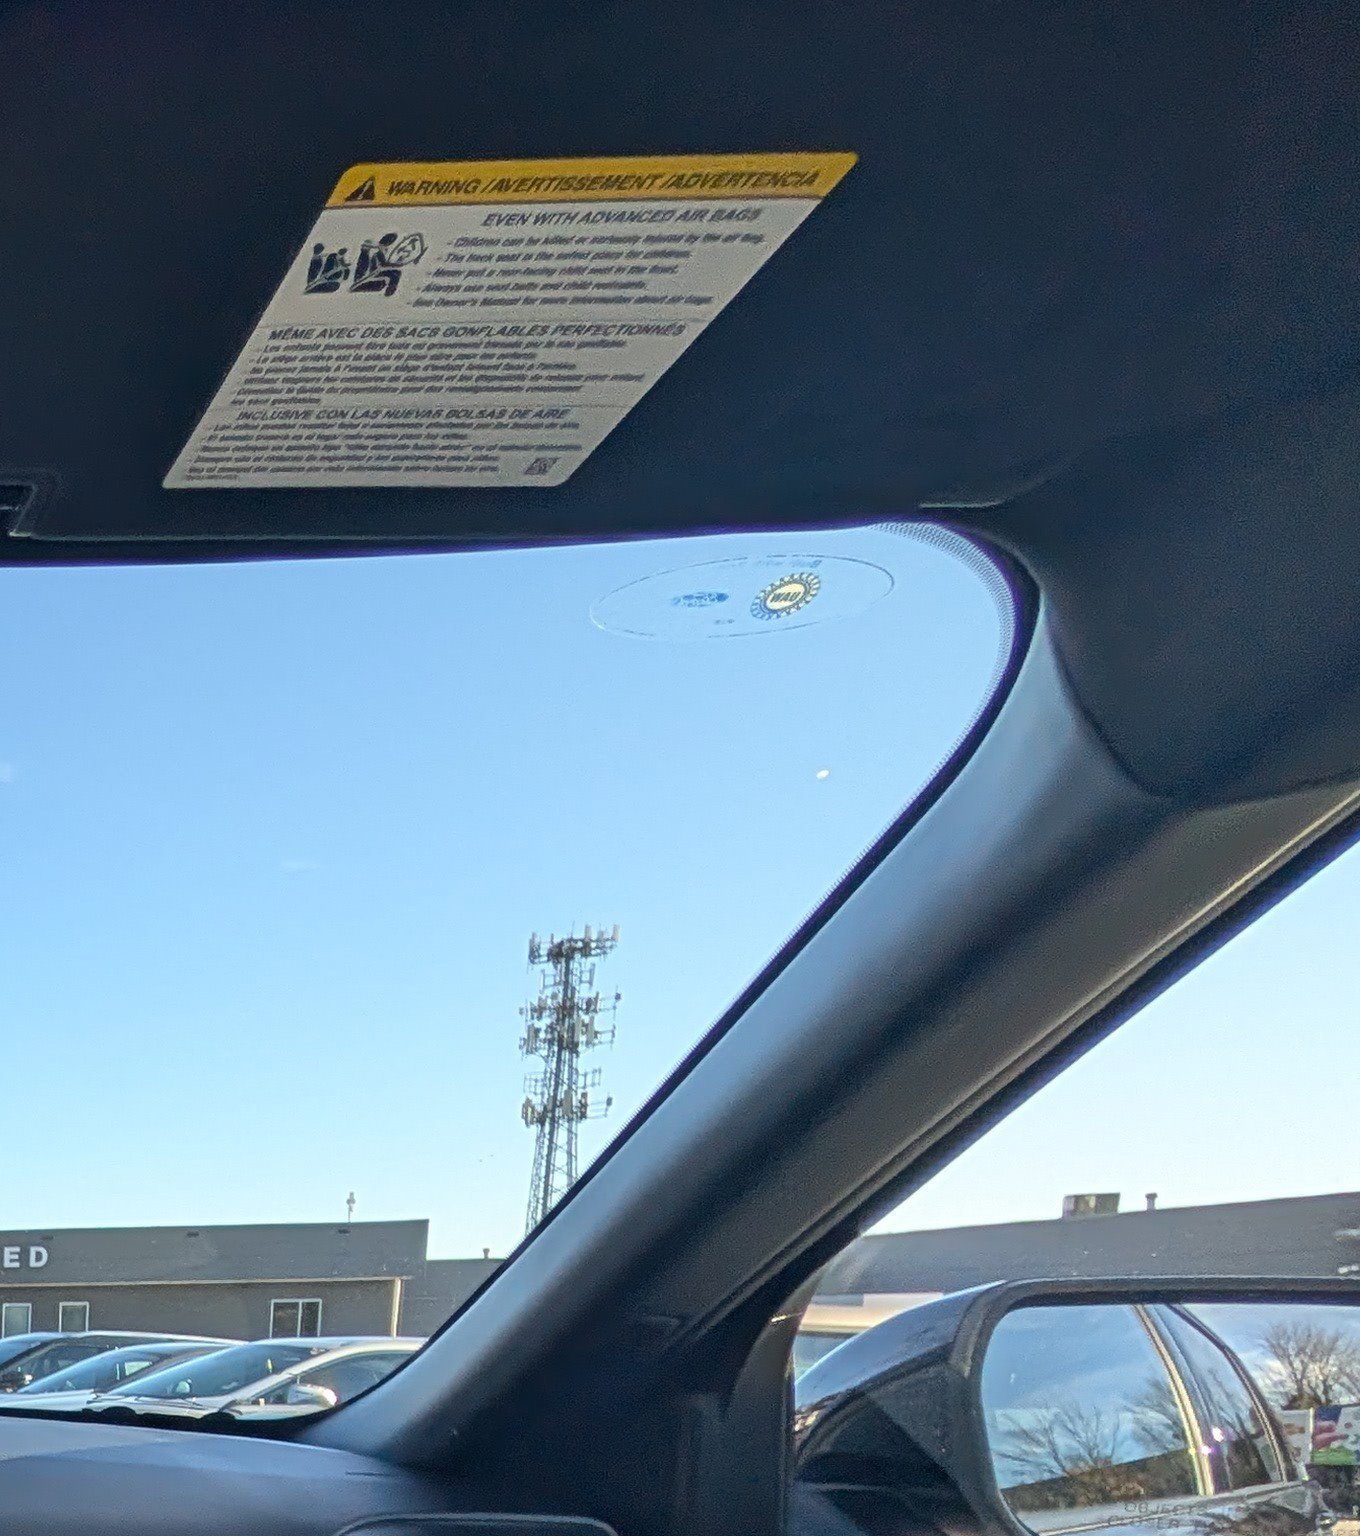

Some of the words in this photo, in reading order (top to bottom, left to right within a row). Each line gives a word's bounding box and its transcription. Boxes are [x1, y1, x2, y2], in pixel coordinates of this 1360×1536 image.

[388, 177, 482, 196] WARNING
[481, 211, 532, 227] EVEN
[532, 210, 579, 226] WITH
[577, 208, 678, 225] ADVANCED
[676, 208, 711, 222] AIR
[709, 206, 763, 222] BAGS
[315, 328, 358, 339] AVEC
[237, 410, 313, 421] INCLUSIVE
[315, 410, 349, 420] CON
[350, 409, 381, 420] LAS
